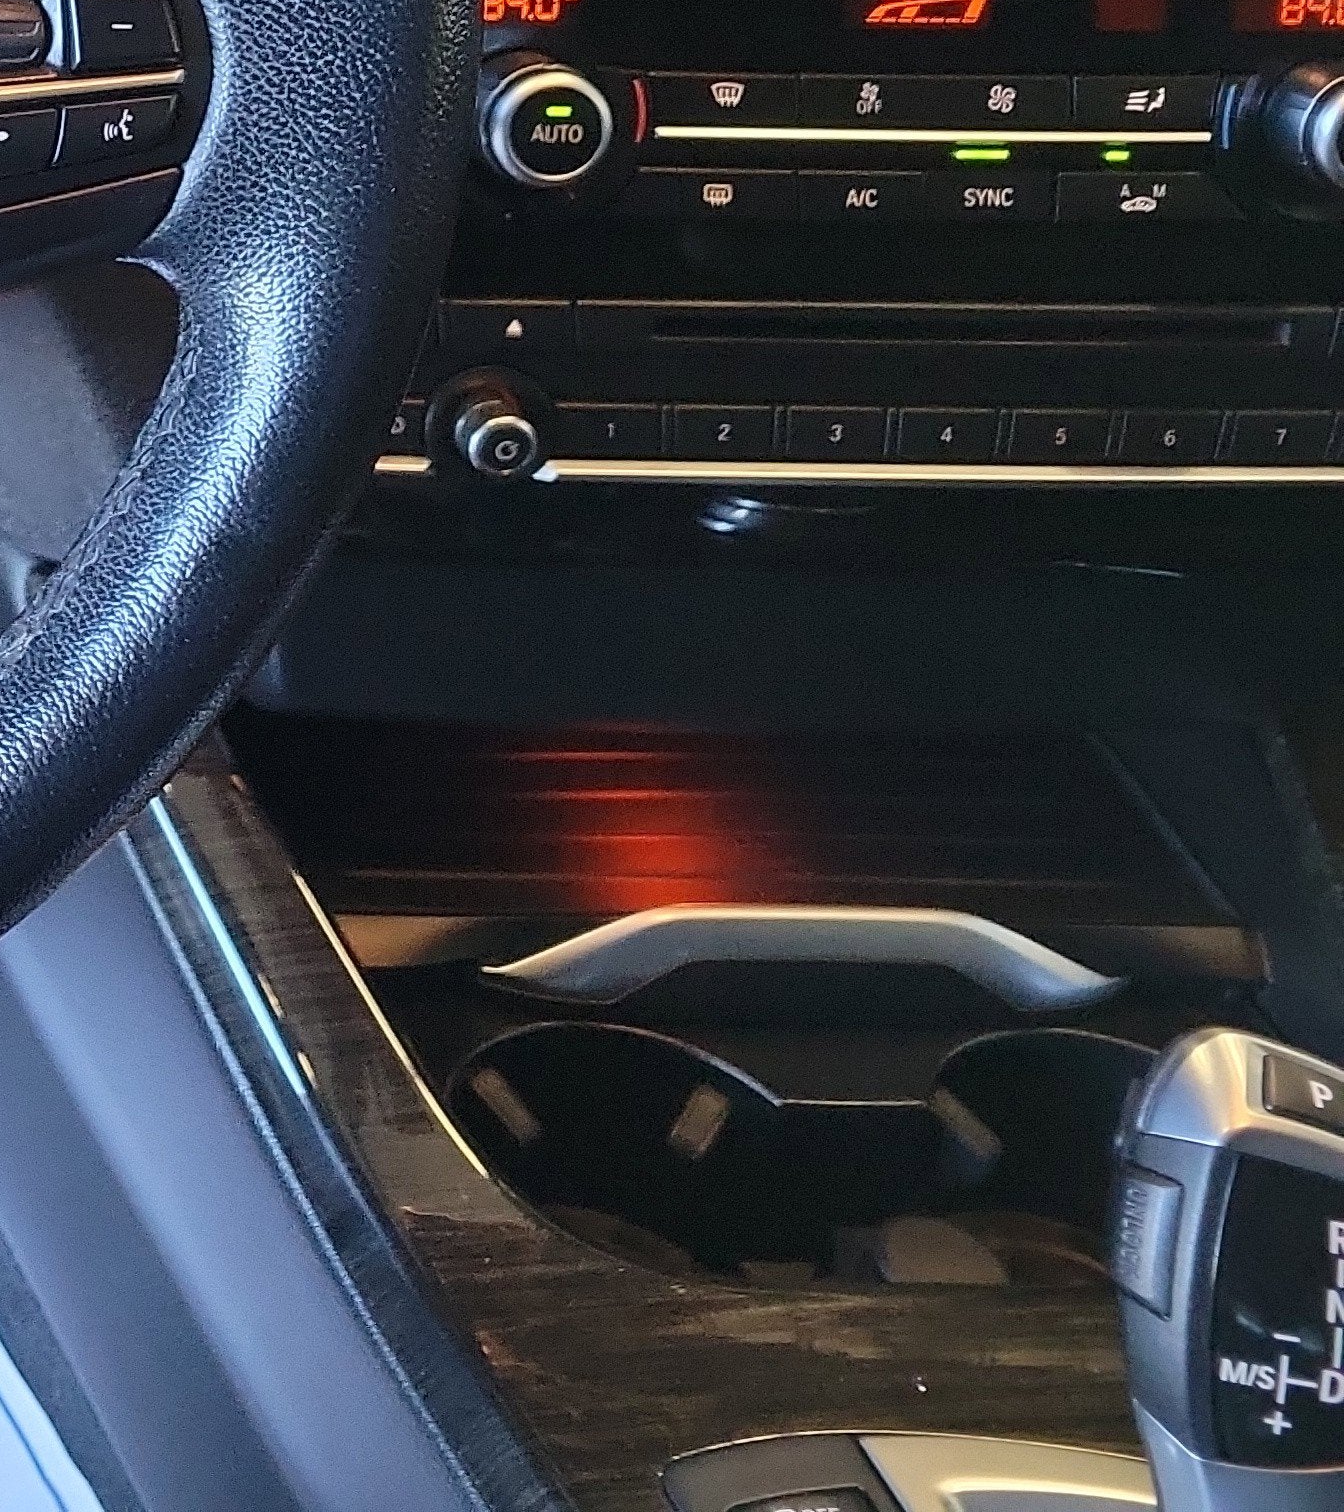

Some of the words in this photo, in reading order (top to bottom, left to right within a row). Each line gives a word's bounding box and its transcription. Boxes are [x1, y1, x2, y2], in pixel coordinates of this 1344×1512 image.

[856, 99, 882, 115] OFF
[530, 123, 585, 144] AUTO
[845, 188, 879, 209] A/C
[963, 188, 1014, 209] SYNC
[607, 423, 616, 439] 1
[718, 424, 732, 441] 2
[829, 424, 844, 443] 3
[940, 426, 954, 443] 4
[1055, 428, 1068, 445] 5
[1163, 429, 1176, 447] 6
[1275, 428, 1288, 445] 7
[1309, 1080, 1333, 1109] P
[1219, 1357, 1277, 1391] M/S
